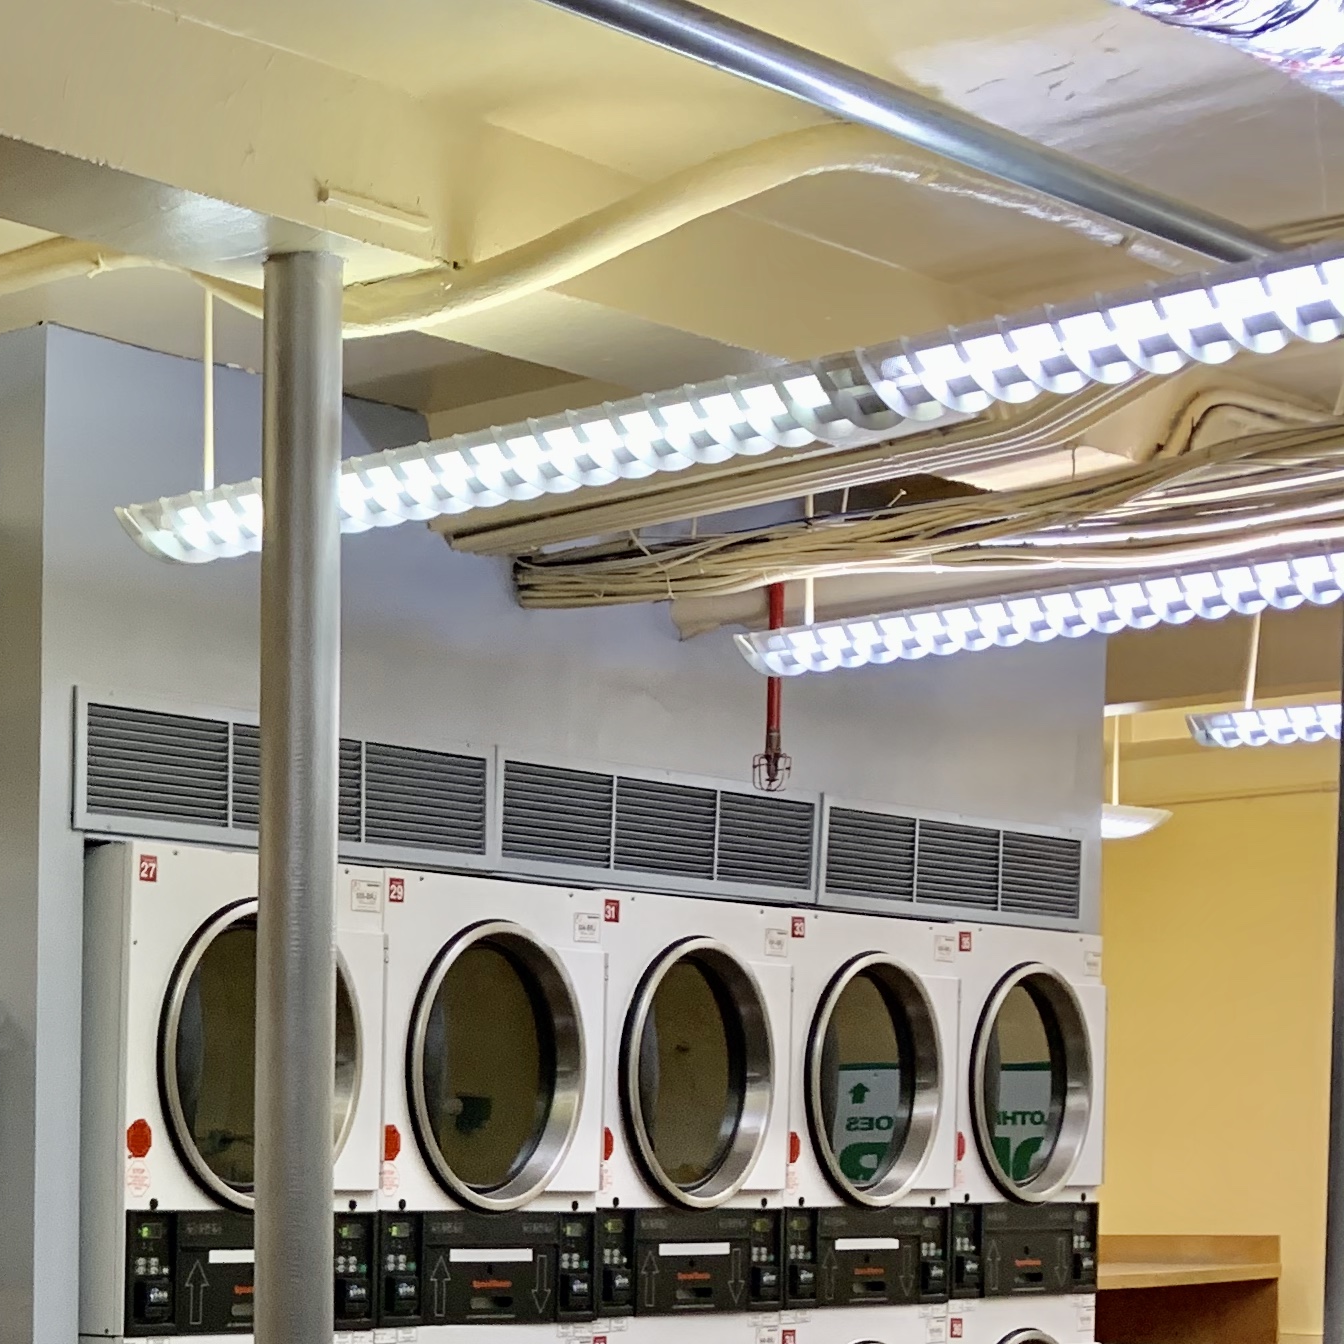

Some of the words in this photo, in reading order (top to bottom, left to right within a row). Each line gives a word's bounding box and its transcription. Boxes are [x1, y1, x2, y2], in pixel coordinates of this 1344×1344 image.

[140, 861, 157, 879] 27
[389, 884, 404, 901] 29
[605, 905, 616, 919] 31
